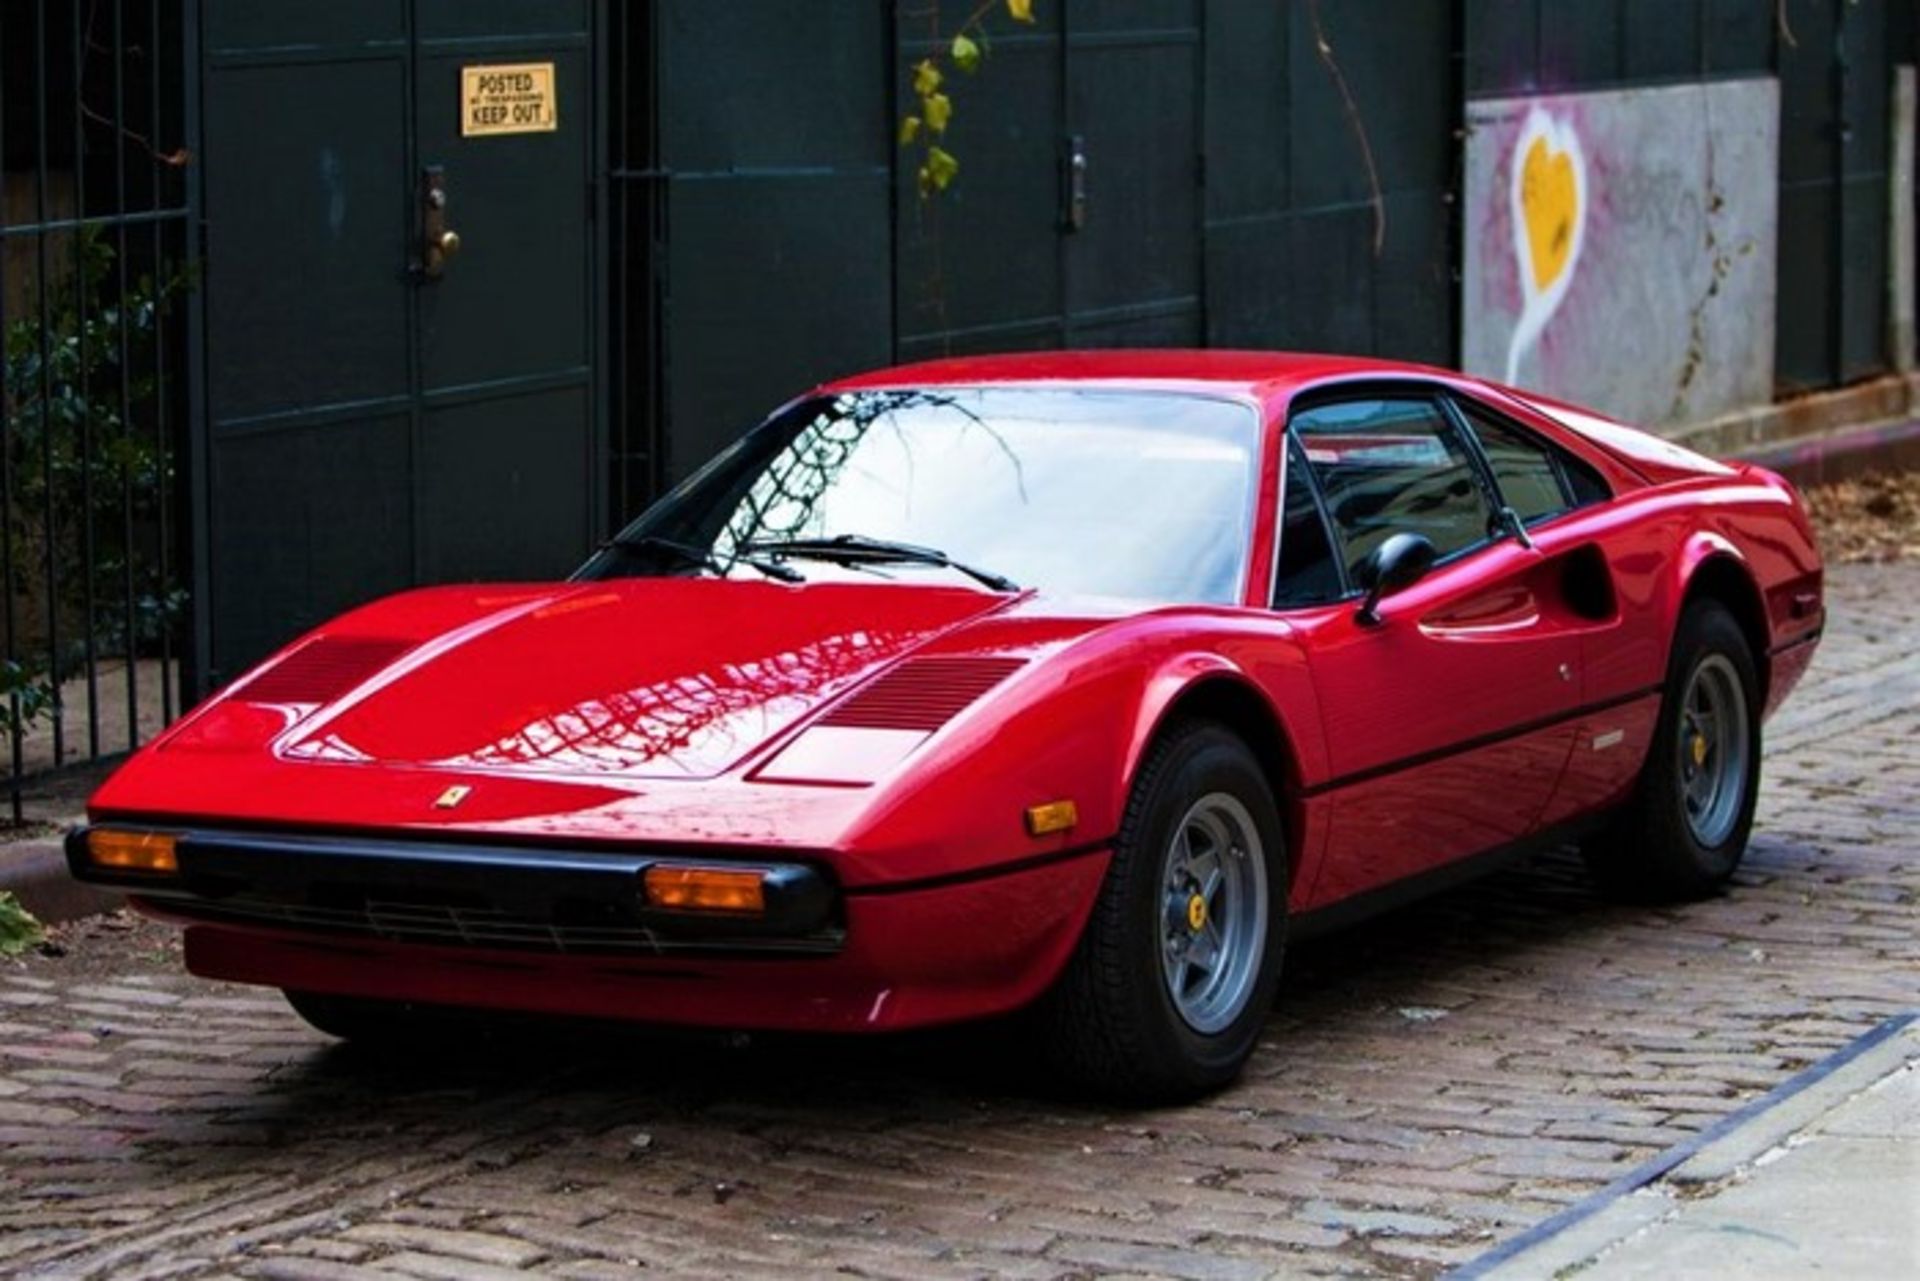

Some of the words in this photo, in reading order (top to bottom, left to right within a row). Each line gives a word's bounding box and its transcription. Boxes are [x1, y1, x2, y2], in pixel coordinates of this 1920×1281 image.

[478, 73, 533, 93] POSTED
[473, 106, 508, 125] KEEP
[512, 103, 541, 123] OUT
